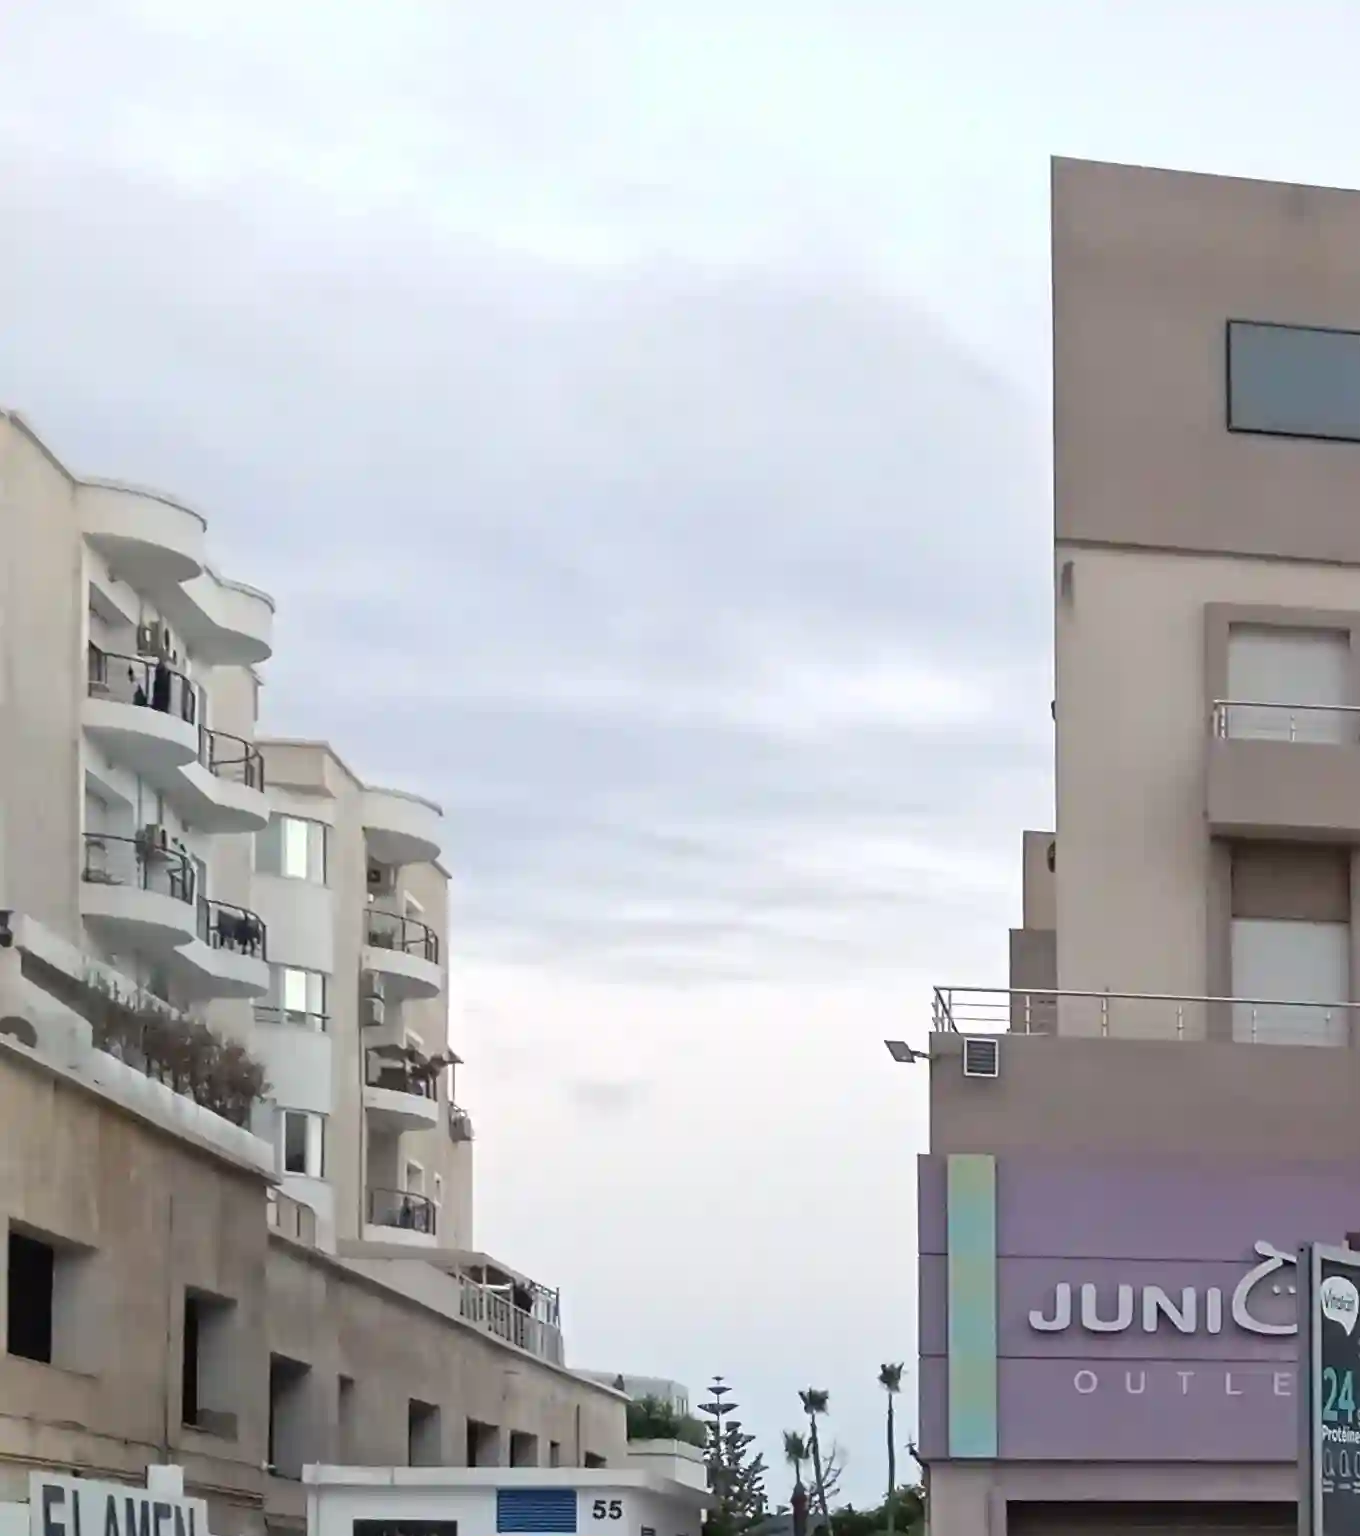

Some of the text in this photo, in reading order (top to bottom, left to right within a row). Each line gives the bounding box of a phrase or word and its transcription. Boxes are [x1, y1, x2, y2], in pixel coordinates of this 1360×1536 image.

[1028, 1240, 1298, 1335] JUNIO
[1073, 1369, 1292, 1397] OUTLE
[1322, 1366, 1356, 1423] 24
[591, 1500, 622, 1520] 55
